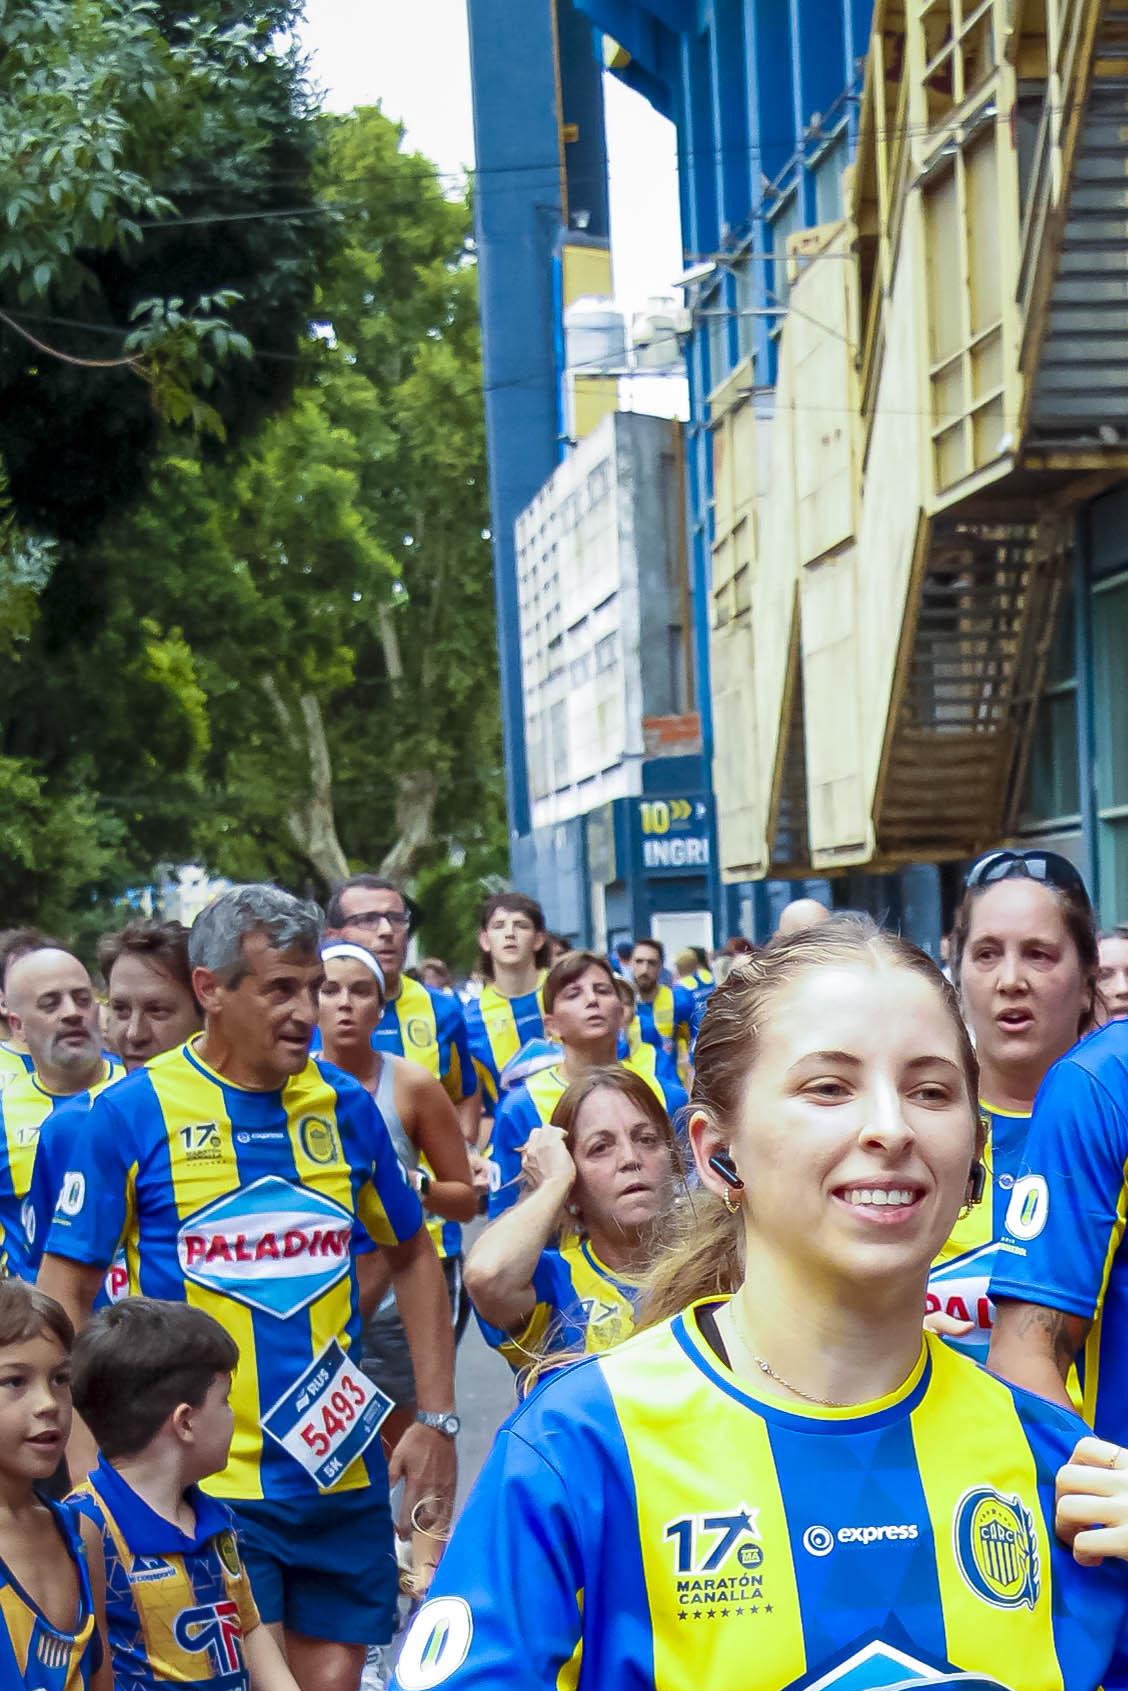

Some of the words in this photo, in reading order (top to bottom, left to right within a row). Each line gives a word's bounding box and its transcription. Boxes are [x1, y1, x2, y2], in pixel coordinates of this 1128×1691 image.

[639, 801, 670, 835] 10
[179, 1122, 218, 1149] 17
[307, 1367, 331, 1396] RUS
[300, 1375, 367, 1457] 5493
[323, 1456, 344, 1478] 5K
[664, 1501, 756, 1576] 17
[837, 1522, 919, 1545] express
[676, 1572, 764, 1593] MARATÓN
[679, 1587, 764, 1606] CANALLA
